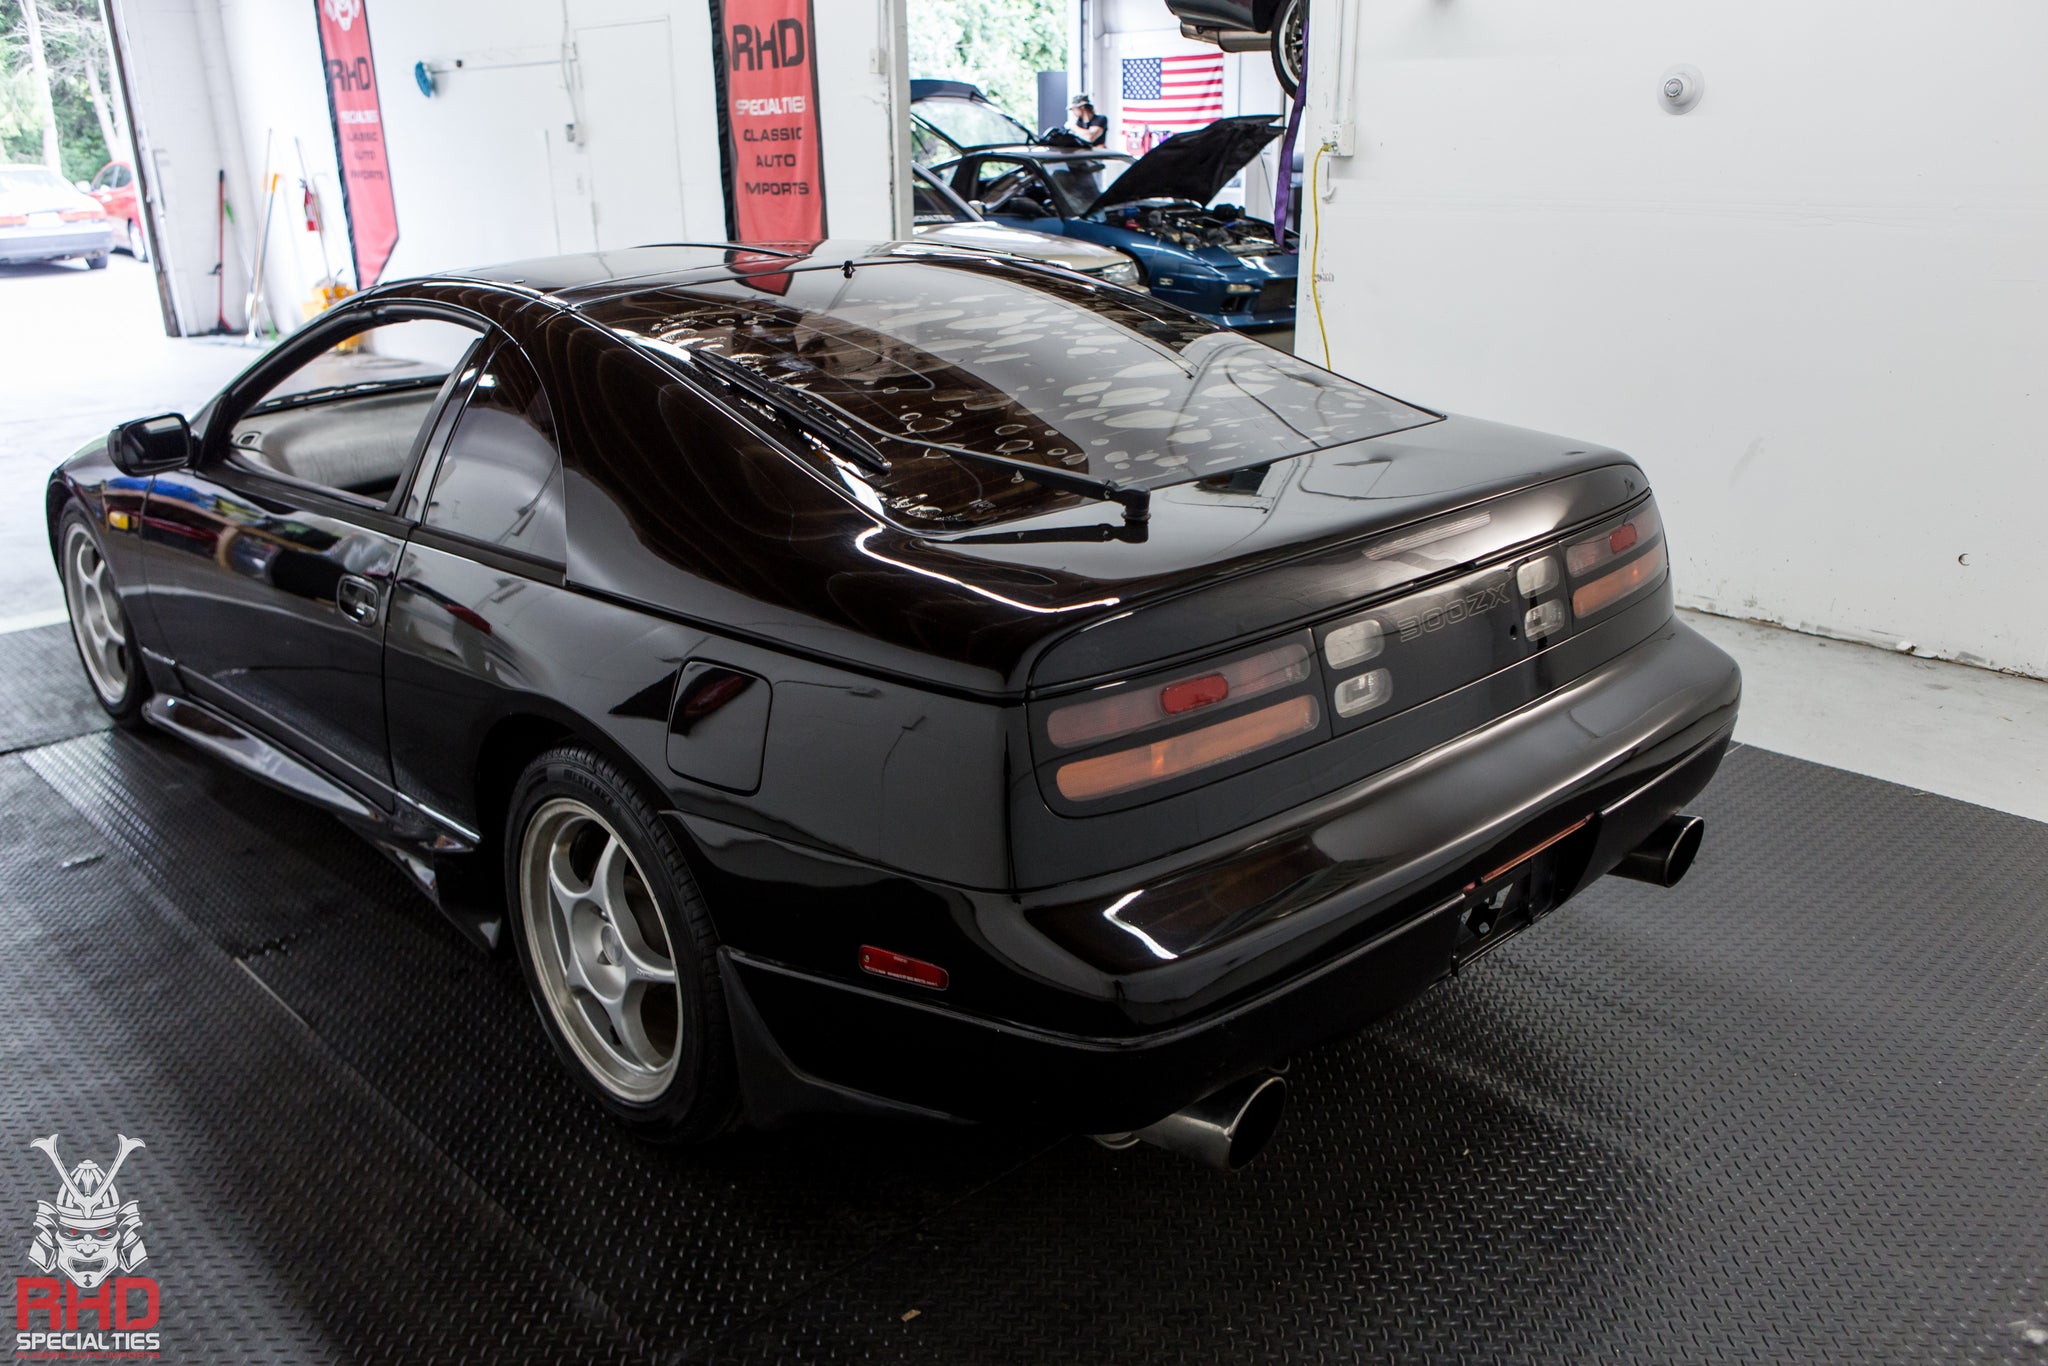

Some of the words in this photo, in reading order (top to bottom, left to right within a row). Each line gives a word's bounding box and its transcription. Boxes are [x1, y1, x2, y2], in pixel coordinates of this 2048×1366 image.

[732, 18, 805, 71] RHD
[330, 56, 371, 91] RHD
[743, 127, 802, 142] CLASSIC
[756, 154, 796, 168] AUTO
[745, 182, 809, 195] MPORTS
[1397, 582, 1511, 643] 300ZX
